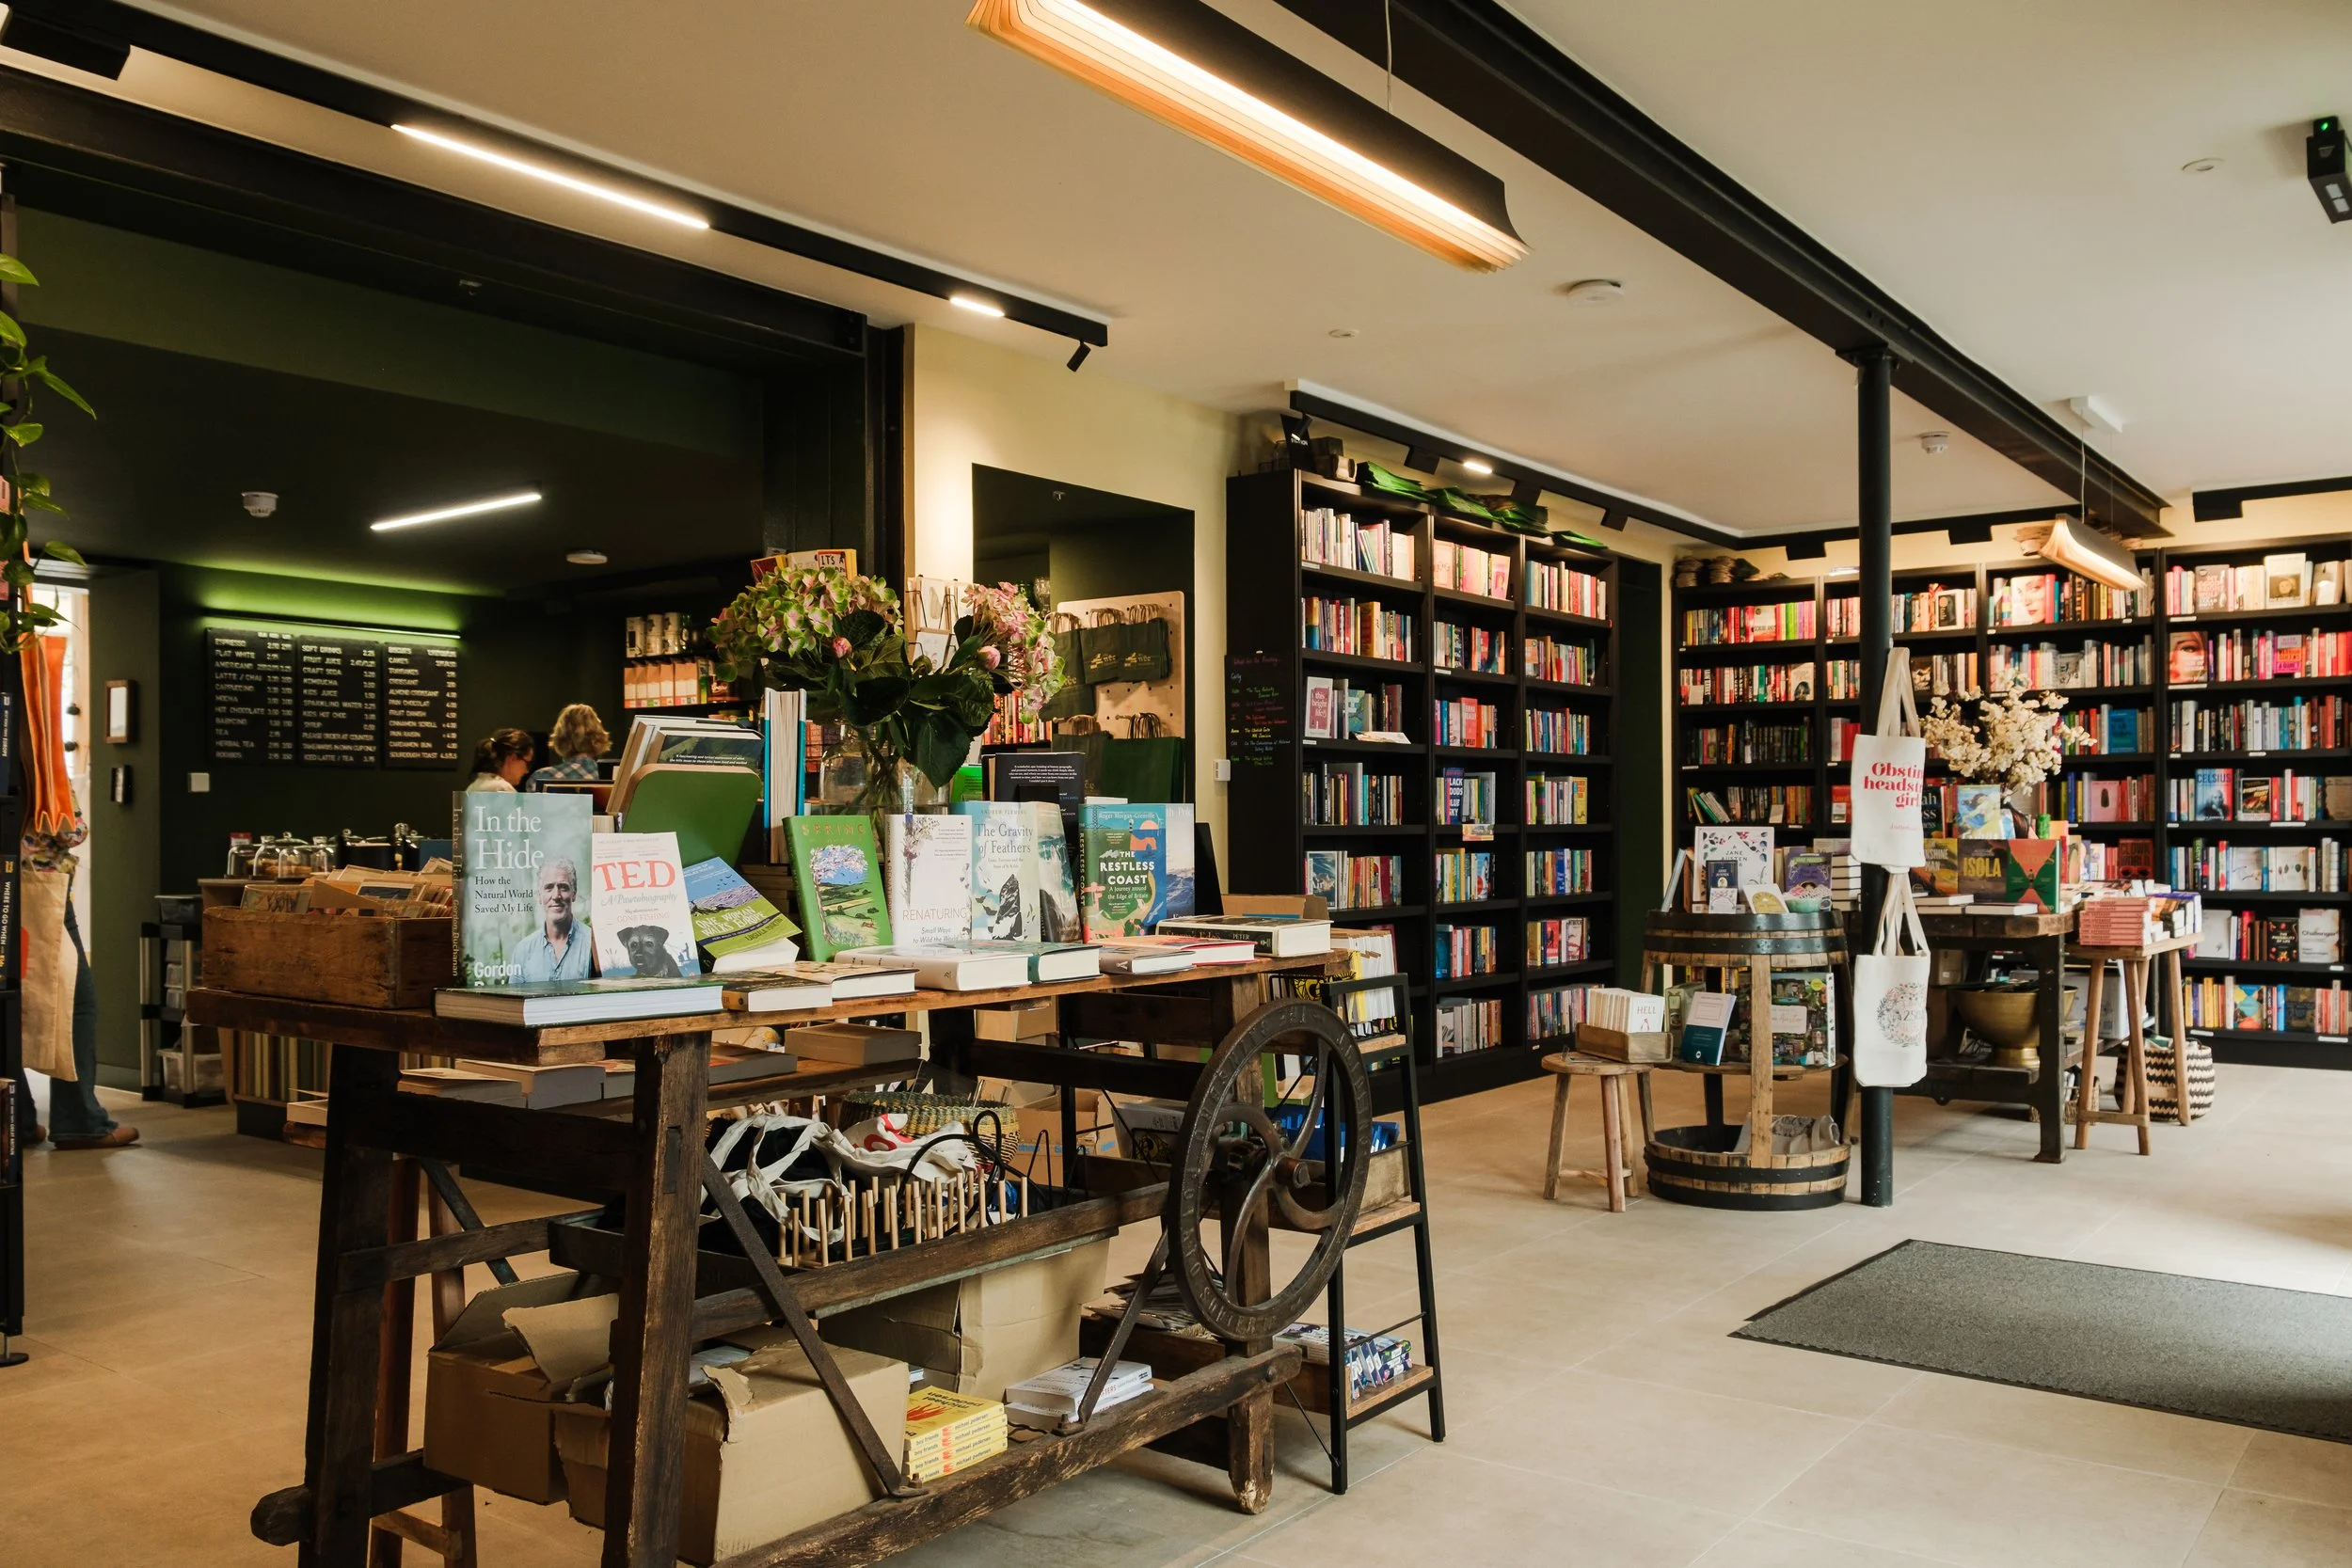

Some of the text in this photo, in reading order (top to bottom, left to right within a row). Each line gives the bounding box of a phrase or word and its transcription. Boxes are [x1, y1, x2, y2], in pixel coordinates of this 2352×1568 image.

[215, 661, 253, 670] AMERICANO
[1449, 778, 1464, 786] LACK
[2197, 773, 2233, 784] CELSIUS
[453, 807, 463, 822] In
[474, 806, 542, 832] In the
[802, 823, 866, 836] SPRING
[975, 824, 995, 836] The
[999, 823, 1033, 841] Gravity
[474, 839, 545, 870] Hide
[978, 841, 990, 858] of
[992, 841, 1031, 853] Feathers
[1100, 862, 1154, 872] RESTLESS
[1963, 857, 2001, 878] ISOLA
[475, 876, 511, 885] How the
[594, 860, 675, 892] TED
[1107, 876, 1147, 885] COAST
[475, 890, 533, 899] Natural World
[601, 892, 678, 907] A Pawtobiography
[2, 904, 9, 913] TO
[475, 904, 533, 915] Saved My Life
[902, 907, 967, 921] RENATURING
[2, 913, 8, 924] GO
[617, 911, 670, 923] GONE FISHING
[696, 907, 755, 929] ONE WOMAN
[701, 912, 768, 937] WALKS EUROPE
[744, 928, 767, 942] URSULA
[920, 935, 933, 943] Wild
[474, 961, 521, 977] Gordon
[1637, 1006, 1656, 1014] HELL
[925, 1433, 939, 1442] friends
[955, 1420, 970, 1430] michael
[971, 1414, 989, 1424] pedersen
[924, 1444, 938, 1452] friends
[955, 1432, 970, 1440] michael
[972, 1424, 991, 1434] pedersen
[956, 1444, 972, 1452] michael
[973, 1436, 991, 1447] pedersen
[956, 1456, 972, 1465] michael
[973, 1449, 992, 1459] pedersen
